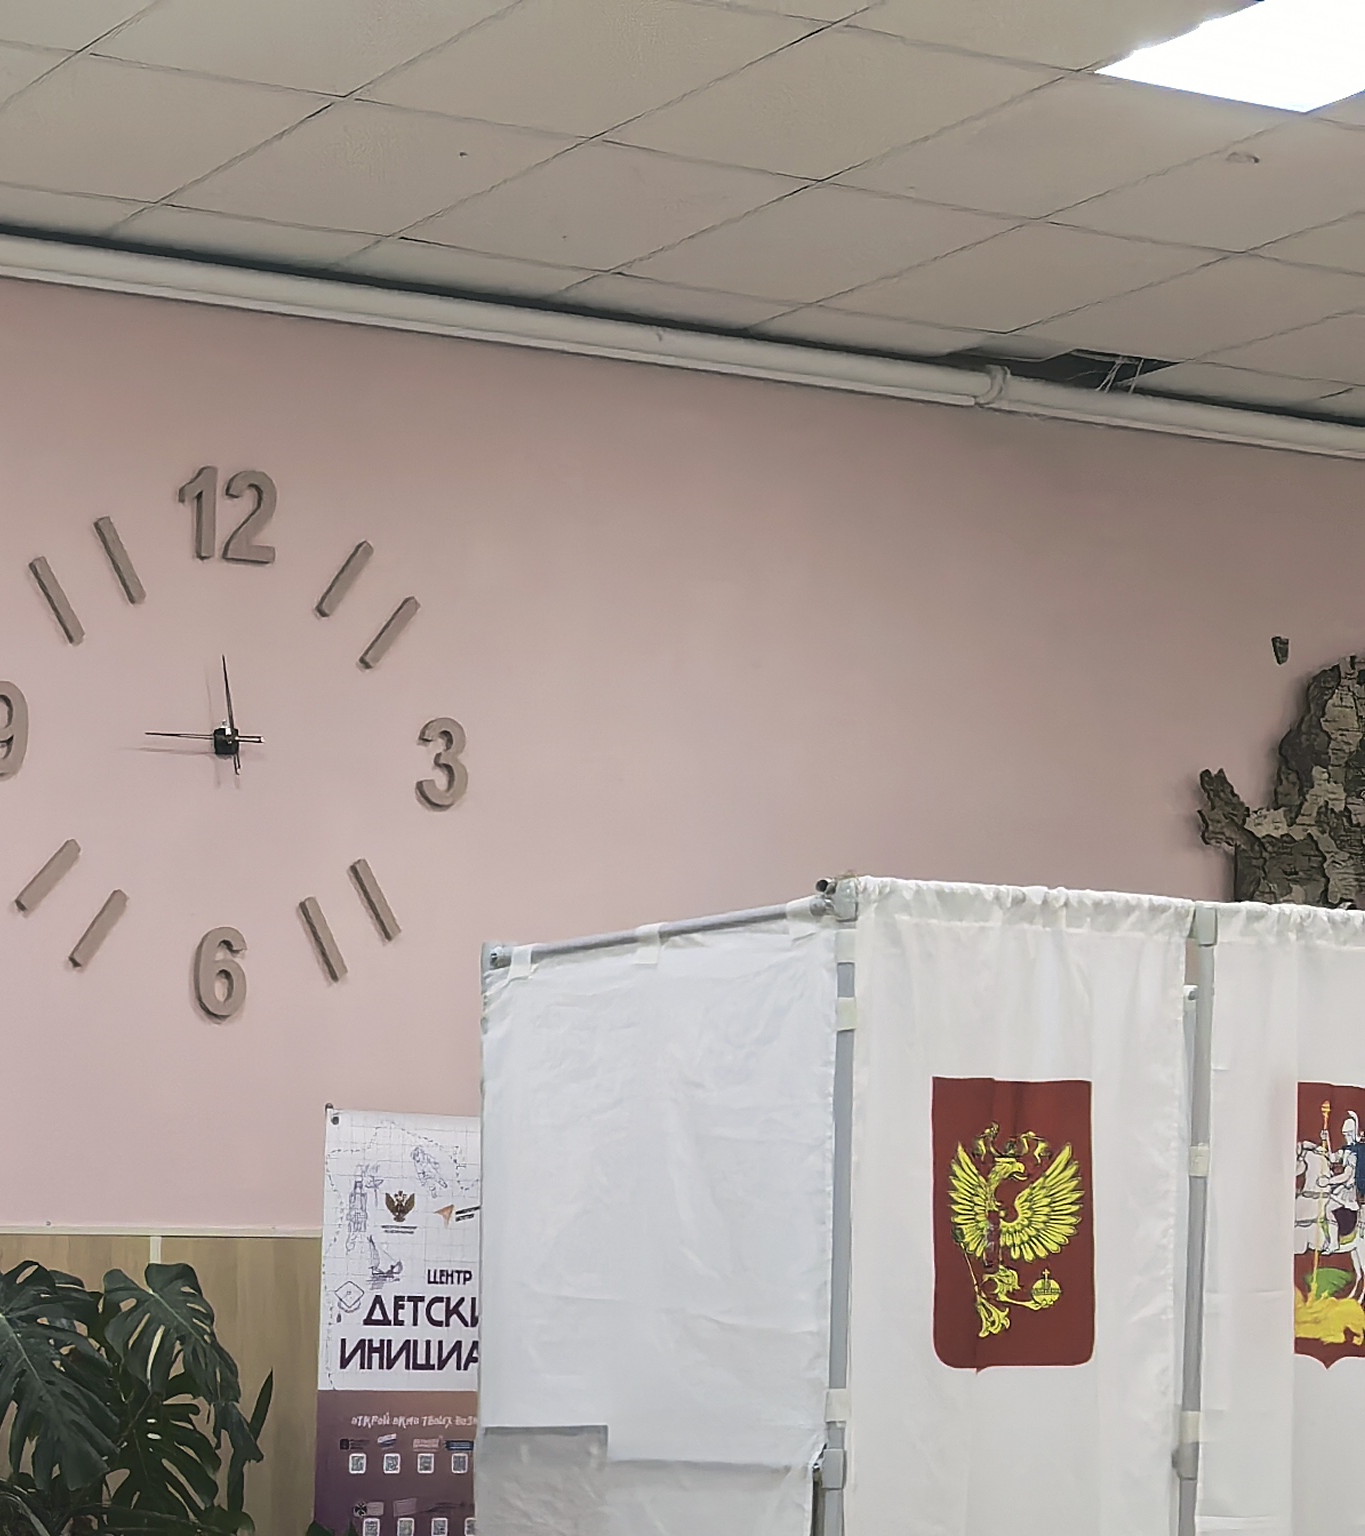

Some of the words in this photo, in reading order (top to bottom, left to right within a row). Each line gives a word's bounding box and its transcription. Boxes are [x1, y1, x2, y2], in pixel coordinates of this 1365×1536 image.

[177, 465, 278, 565] 12
[415, 716, 469, 811] 3
[193, 925, 249, 1023] 6
[427, 1269, 473, 1285] ЦЕНТР
